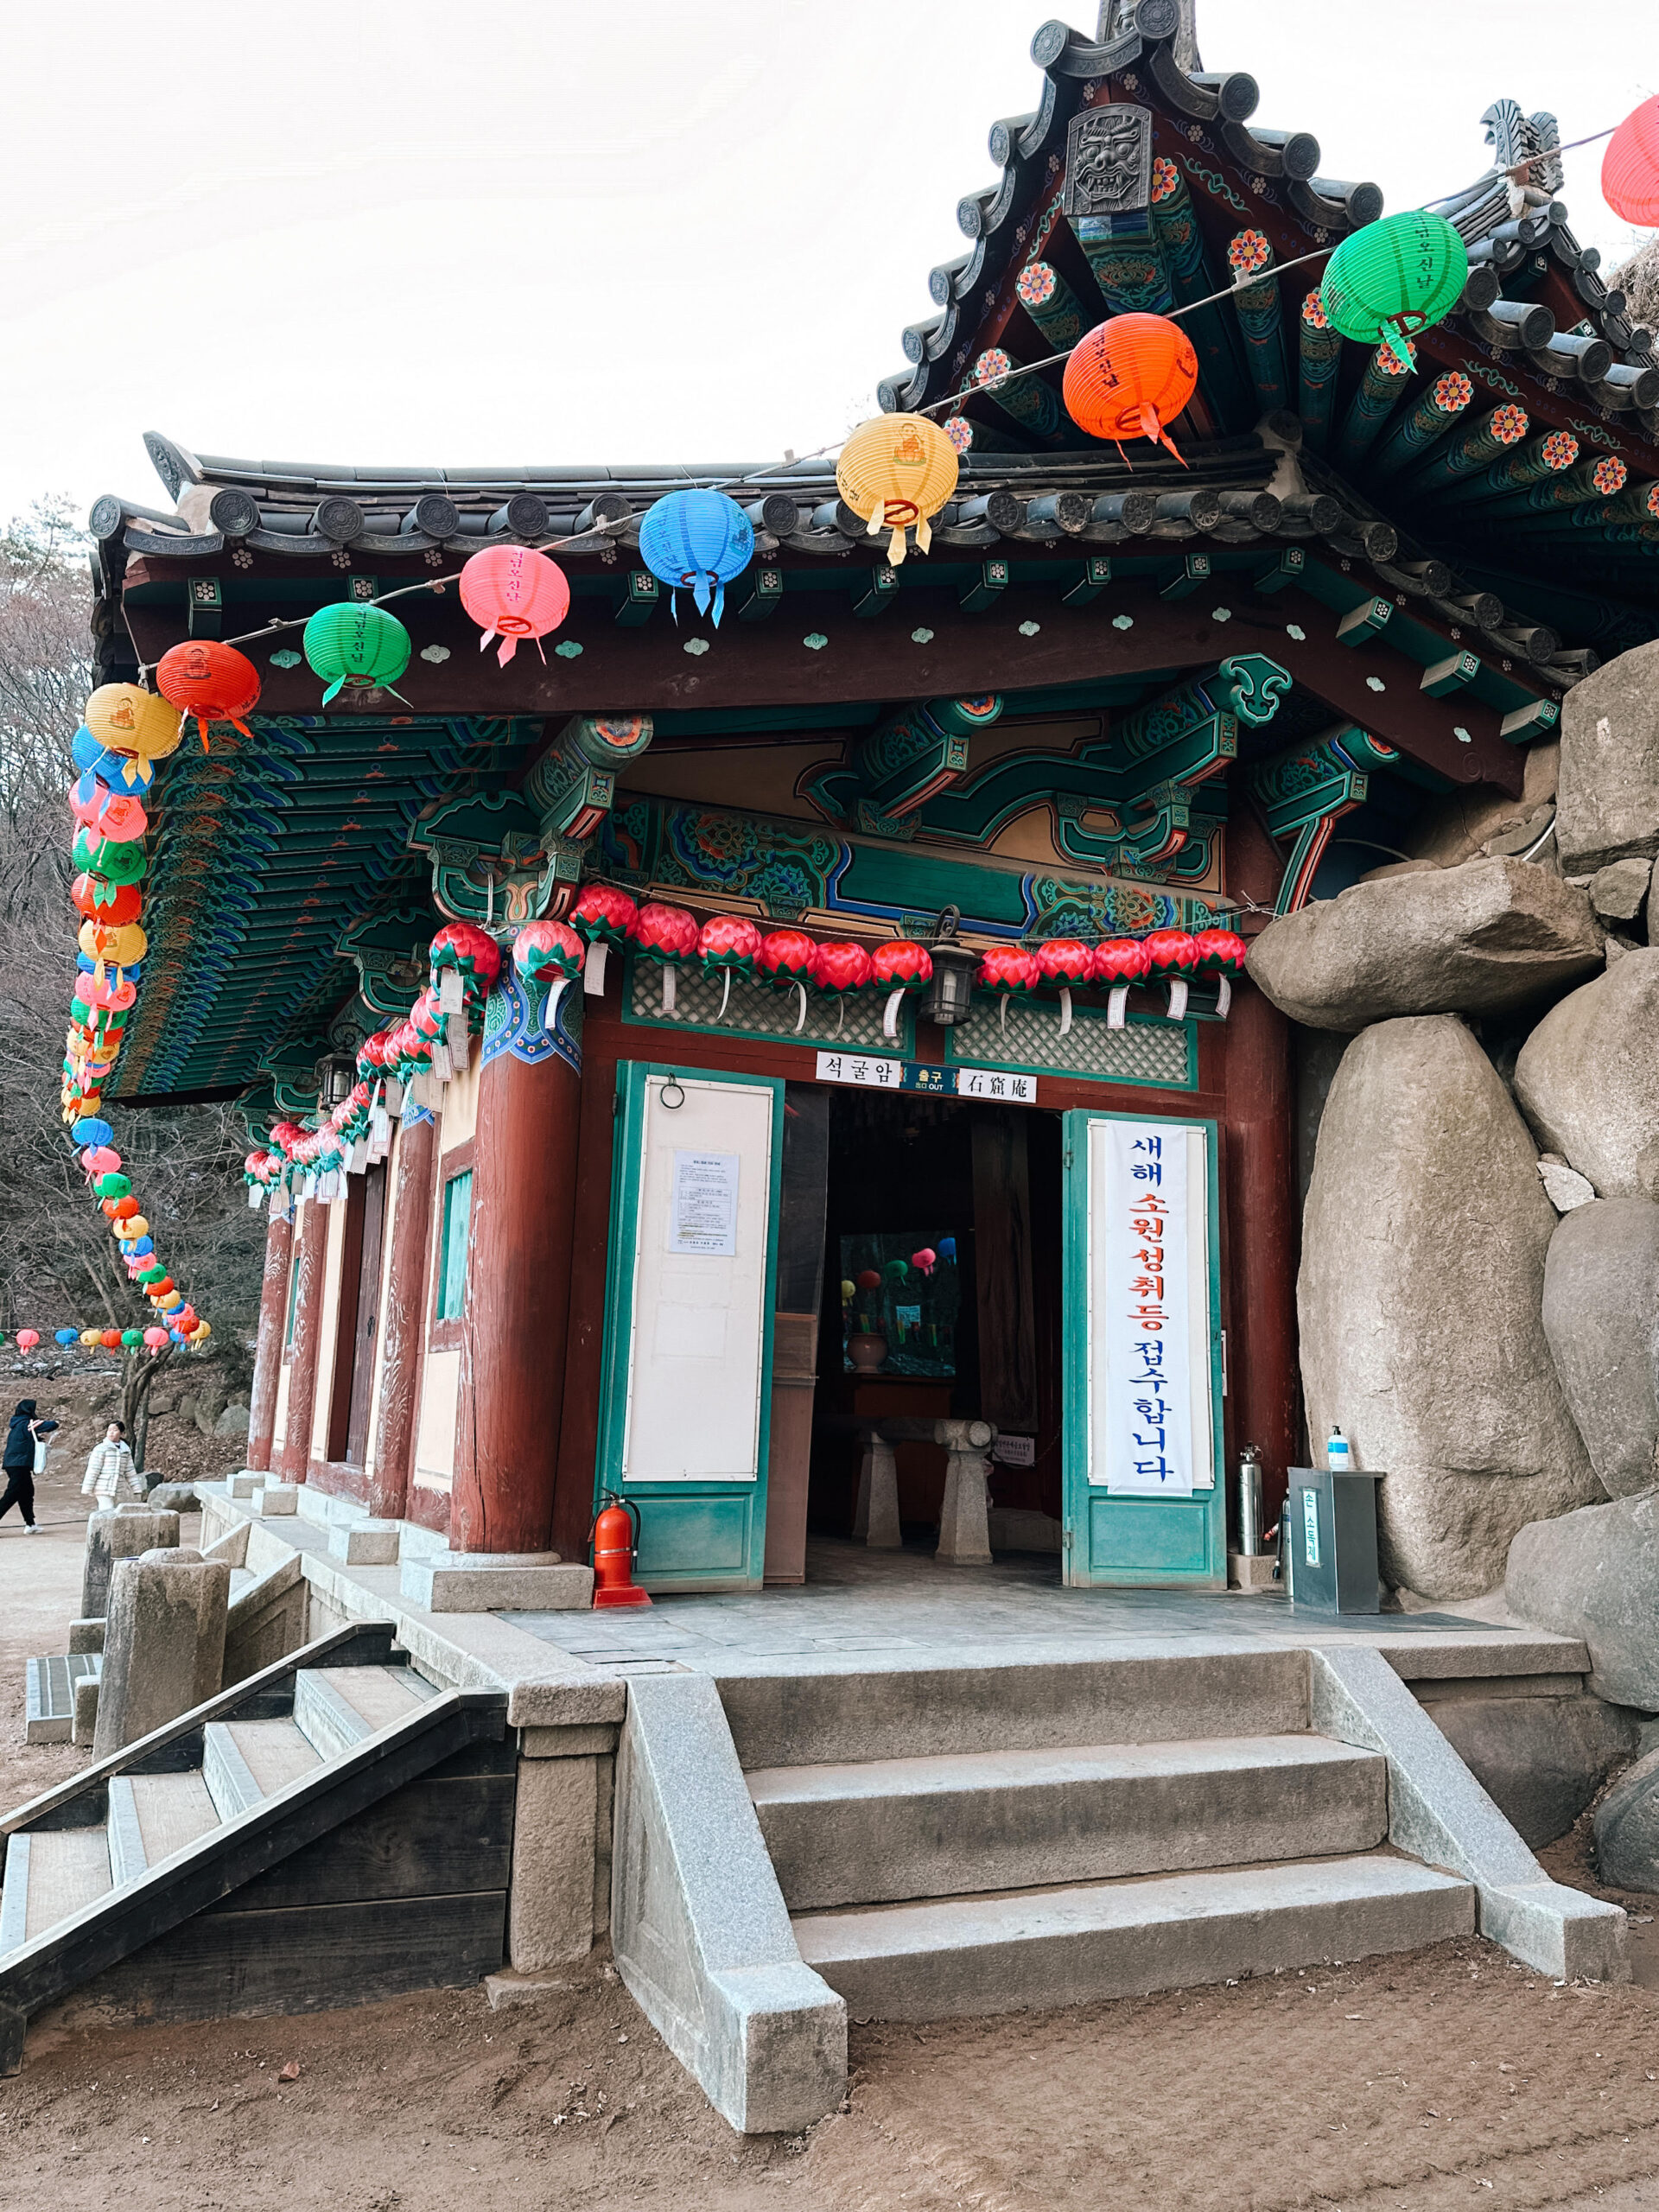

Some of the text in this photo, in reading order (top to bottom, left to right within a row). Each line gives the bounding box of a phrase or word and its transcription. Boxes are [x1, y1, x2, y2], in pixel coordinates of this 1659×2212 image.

[825, 1055, 893, 1084] 석굴암
[918, 1069, 943, 1084] 출구
[928, 1083, 944, 1092] OUT
[1128, 1135, 1174, 1483] 새해 소원성취등 접수합니다
[1305, 1493, 1316, 1561] 손 소독제
